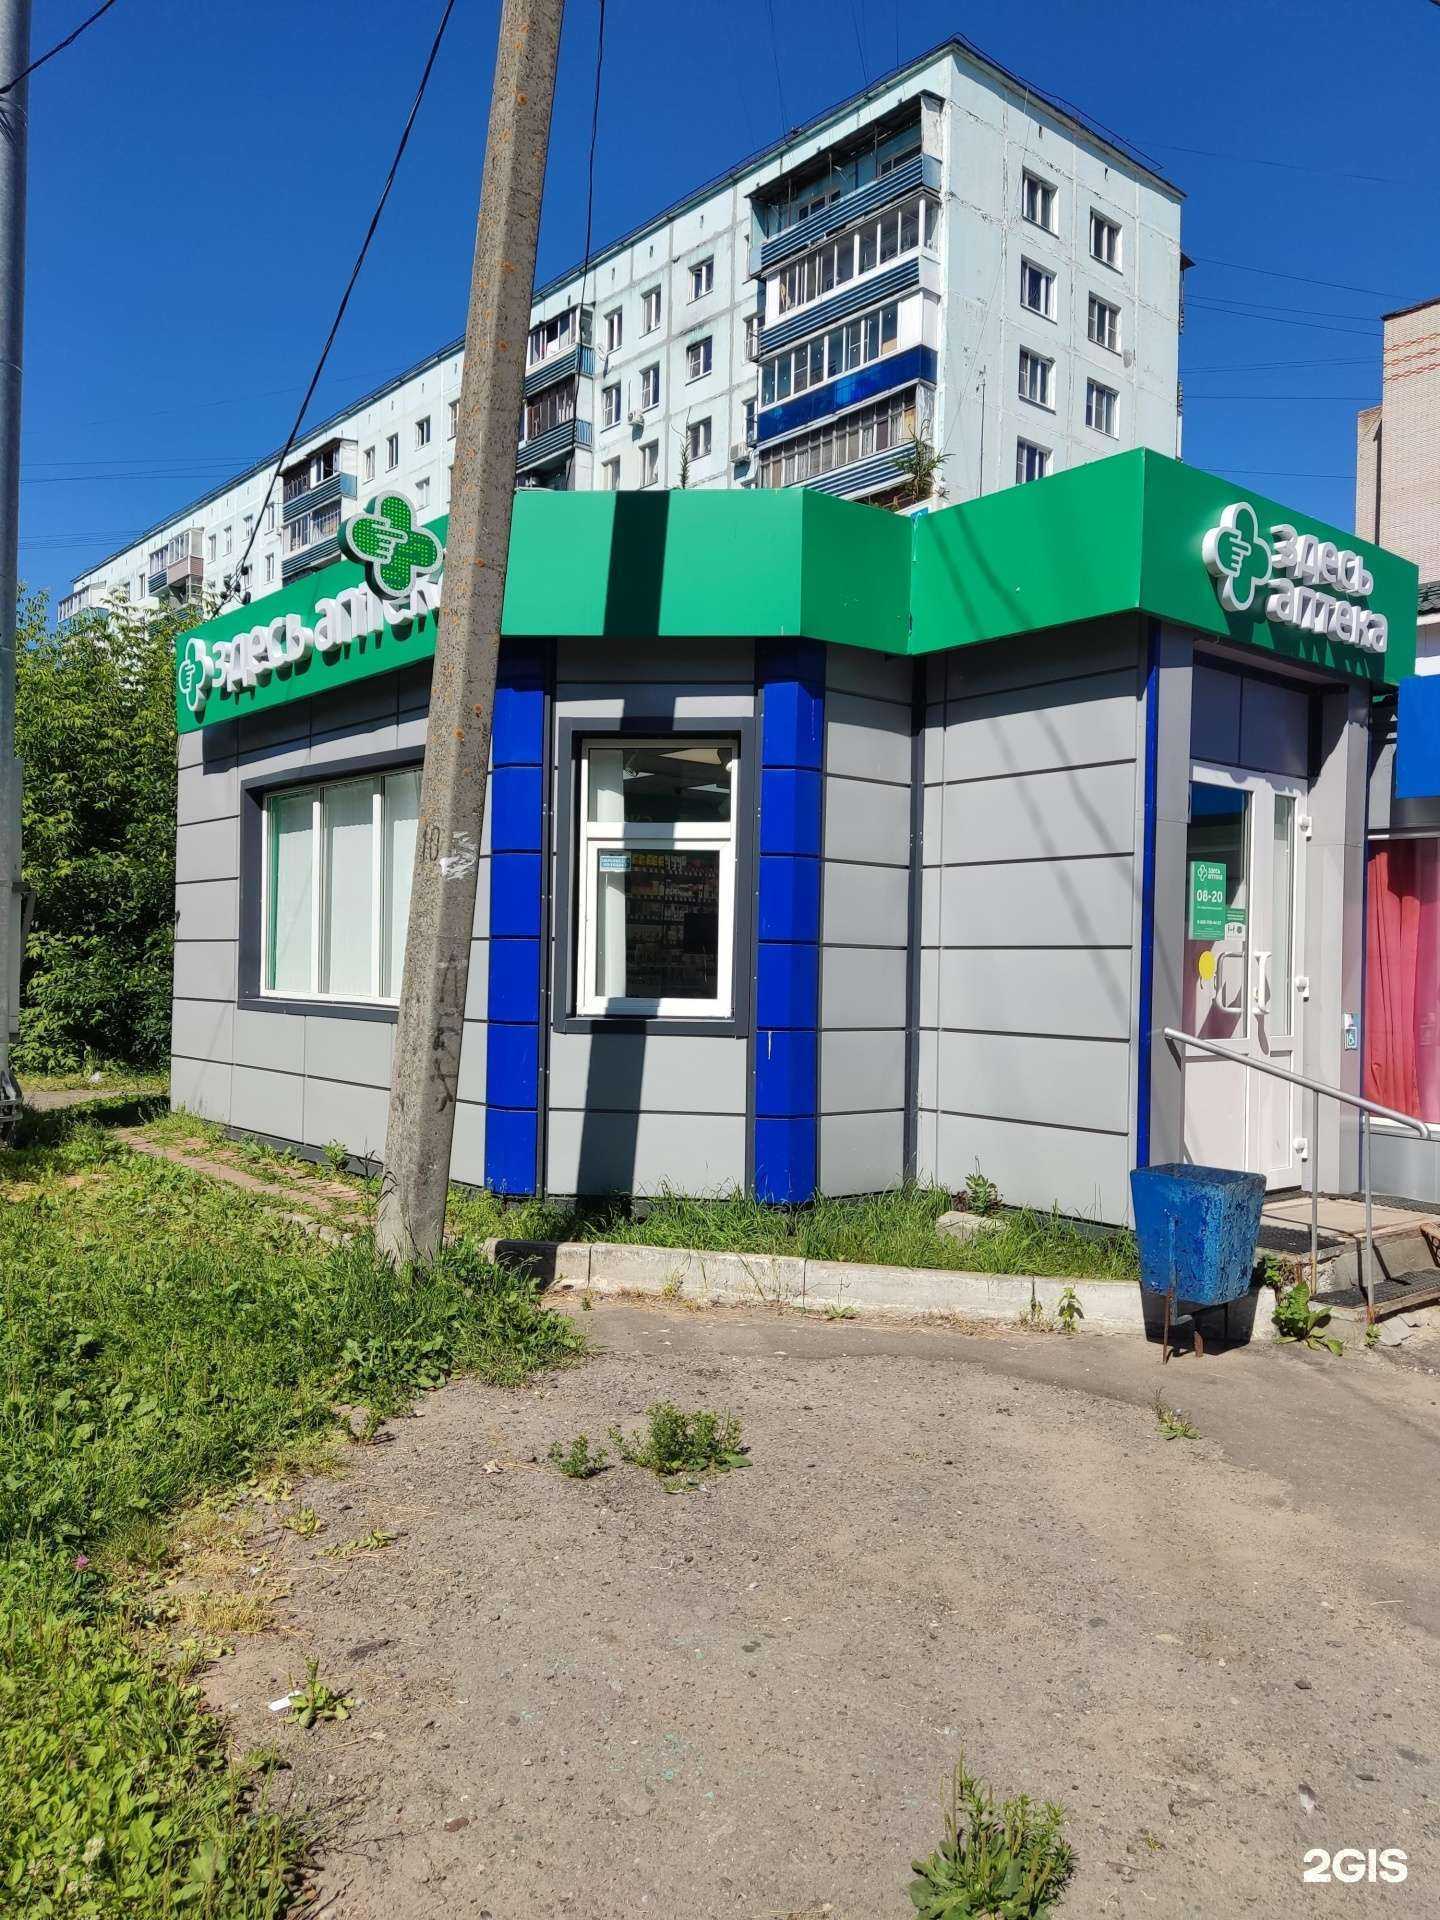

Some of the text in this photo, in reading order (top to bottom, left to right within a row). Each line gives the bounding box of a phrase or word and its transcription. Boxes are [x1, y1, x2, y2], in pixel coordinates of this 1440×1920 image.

[1270, 523, 1374, 596] здесь
[211, 573, 443, 693] здесь аптк
[1266, 578, 1389, 653] аптека
[1196, 889, 1223, 903] 08-20
